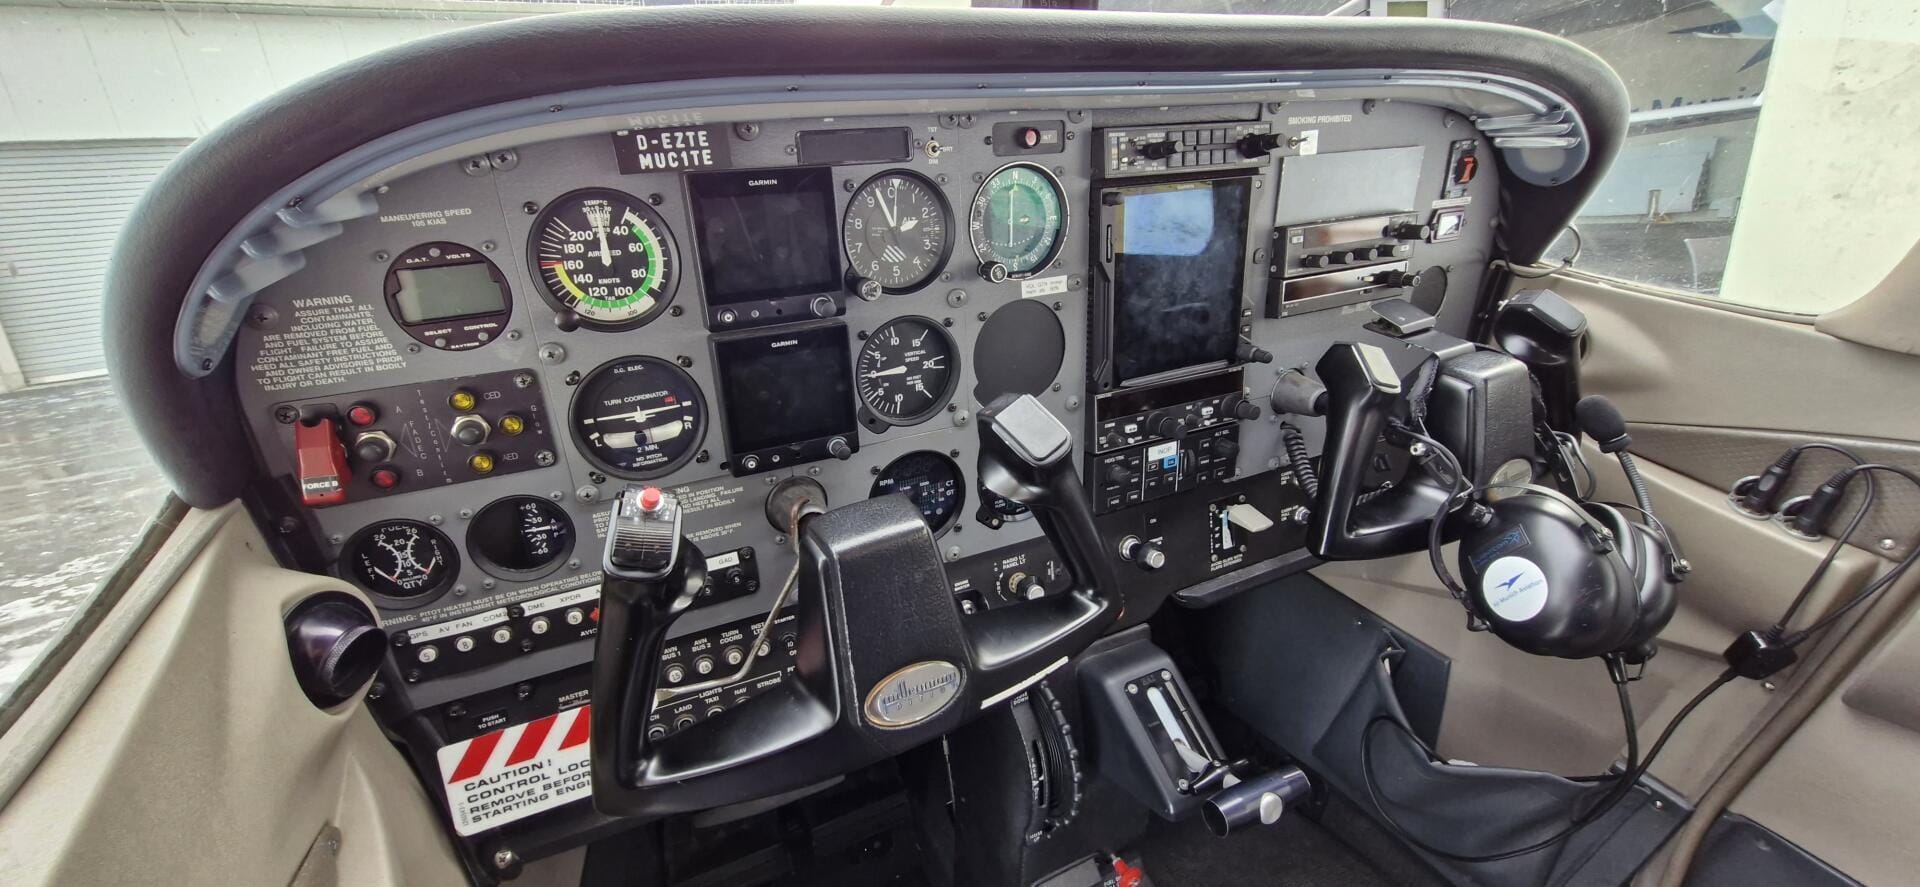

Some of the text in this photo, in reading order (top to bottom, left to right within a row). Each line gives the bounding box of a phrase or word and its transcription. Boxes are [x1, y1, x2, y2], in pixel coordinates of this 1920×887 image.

[1288, 114, 1352, 125] SMOKING PROHIBITED
[636, 130, 709, 150] D-EZTE
[638, 149, 713, 170] MUC1TE
[866, 196, 875, 208] 9
[380, 208, 472, 223] MANEUVERING SPEED
[921, 207, 929, 219] 2
[412, 217, 447, 227] 105 KIAS
[854, 218, 862, 229] 8
[569, 231, 593, 241] 200
[612, 226, 629, 236] 40
[564, 244, 584, 253] 180
[629, 243, 644, 252] 60
[855, 243, 863, 253] 7
[923, 239, 932, 250] 3
[564, 260, 583, 270] 160
[871, 260, 879, 271] 6
[631, 269, 646, 278] 80
[892, 266, 901, 276] 5
[574, 274, 593, 284] 140
[588, 287, 608, 296] 120
[614, 287, 633, 296] 100
[292, 295, 353, 309] WARNING
[295, 307, 330, 317] ASSURE
[334, 305, 355, 314] THAT
[291, 321, 340, 332] INCLUDING
[463, 322, 498, 330] CONTROL
[284, 330, 328, 340] REMOVED
[330, 328, 355, 336] FROM
[358, 325, 380, 333] FUEL
[424, 328, 452, 336] SELECT
[287, 339, 310, 347] FUEL
[312, 335, 347, 345] SYSTEM
[350, 331, 384, 340] BEFORE
[771, 340, 798, 348] GARMIN
[890, 337, 900, 346] 10
[912, 338, 921, 347] 15
[301, 343, 337, 352] FAILURE
[355, 337, 389, 346] ASSURE
[257, 351, 325, 364] CONTAMINANT
[904, 349, 926, 357] VERTICAL
[251, 363, 276, 371] HEED
[299, 358, 331, 367] SAFETY
[334, 349, 398, 362] INSTRUCTIONS
[922, 360, 934, 369] 20
[288, 366, 321, 375] OWNER
[323, 360, 374, 371] ADVISORIES
[377, 356, 403, 364] PRIOR
[273, 375, 305, 383] FLIGHT
[329, 368, 362, 377] RESULT
[376, 362, 407, 371] BODILY
[264, 383, 297, 392] INJURY
[915, 382, 924, 391] 15
[484, 391, 501, 400] CED
[604, 398, 622, 407] TURN
[624, 390, 668, 403] COORDINATOR
[894, 394, 903, 402] 10
[684, 421, 692, 430] R
[409, 420, 427, 459] FADEC
[594, 439, 602, 448] L
[632, 457, 668, 468] INFORMATION
[416, 469, 424, 477] B
[303, 481, 330, 490] FORCE
[880, 478, 894, 486] RPM
[361, 552, 376, 580] LEFT
[403, 579, 422, 589] QTY
[382, 614, 416, 626] RNING:
[420, 608, 441, 617] PITOT
[443, 601, 472, 612] HEATER
[473, 596, 493, 605] MUST
[518, 586, 539, 594] WHEN
[541, 575, 579, 589] OPERATING
[527, 594, 581, 611] DME XPDR
[449, 602, 495, 616] INSTRUMENT
[456, 621, 473, 629] FAN
[721, 629, 739, 638] TURN
[694, 637, 708, 646] AVN
[719, 633, 743, 645] COORD
[664, 646, 678, 654] AVN
[692, 644, 706, 652] BUS
[662, 653, 676, 661] BUS
[757, 677, 781, 689] STROBE
[558, 690, 589, 702] MASTER
[699, 687, 723, 699] LIGHTS
[734, 687, 747, 696] NAV
[705, 696, 720, 704] TAXI
[674, 704, 693, 714] LAND
[482, 714, 499, 722] PUSH
[487, 717, 507, 727] START
[467, 759, 591, 804] CONTROL LOC
[470, 788, 535, 815] REMOVE
[542, 770, 591, 791] BEFOR
[472, 793, 549, 824] STARTING
[556, 779, 591, 796] ENGI
